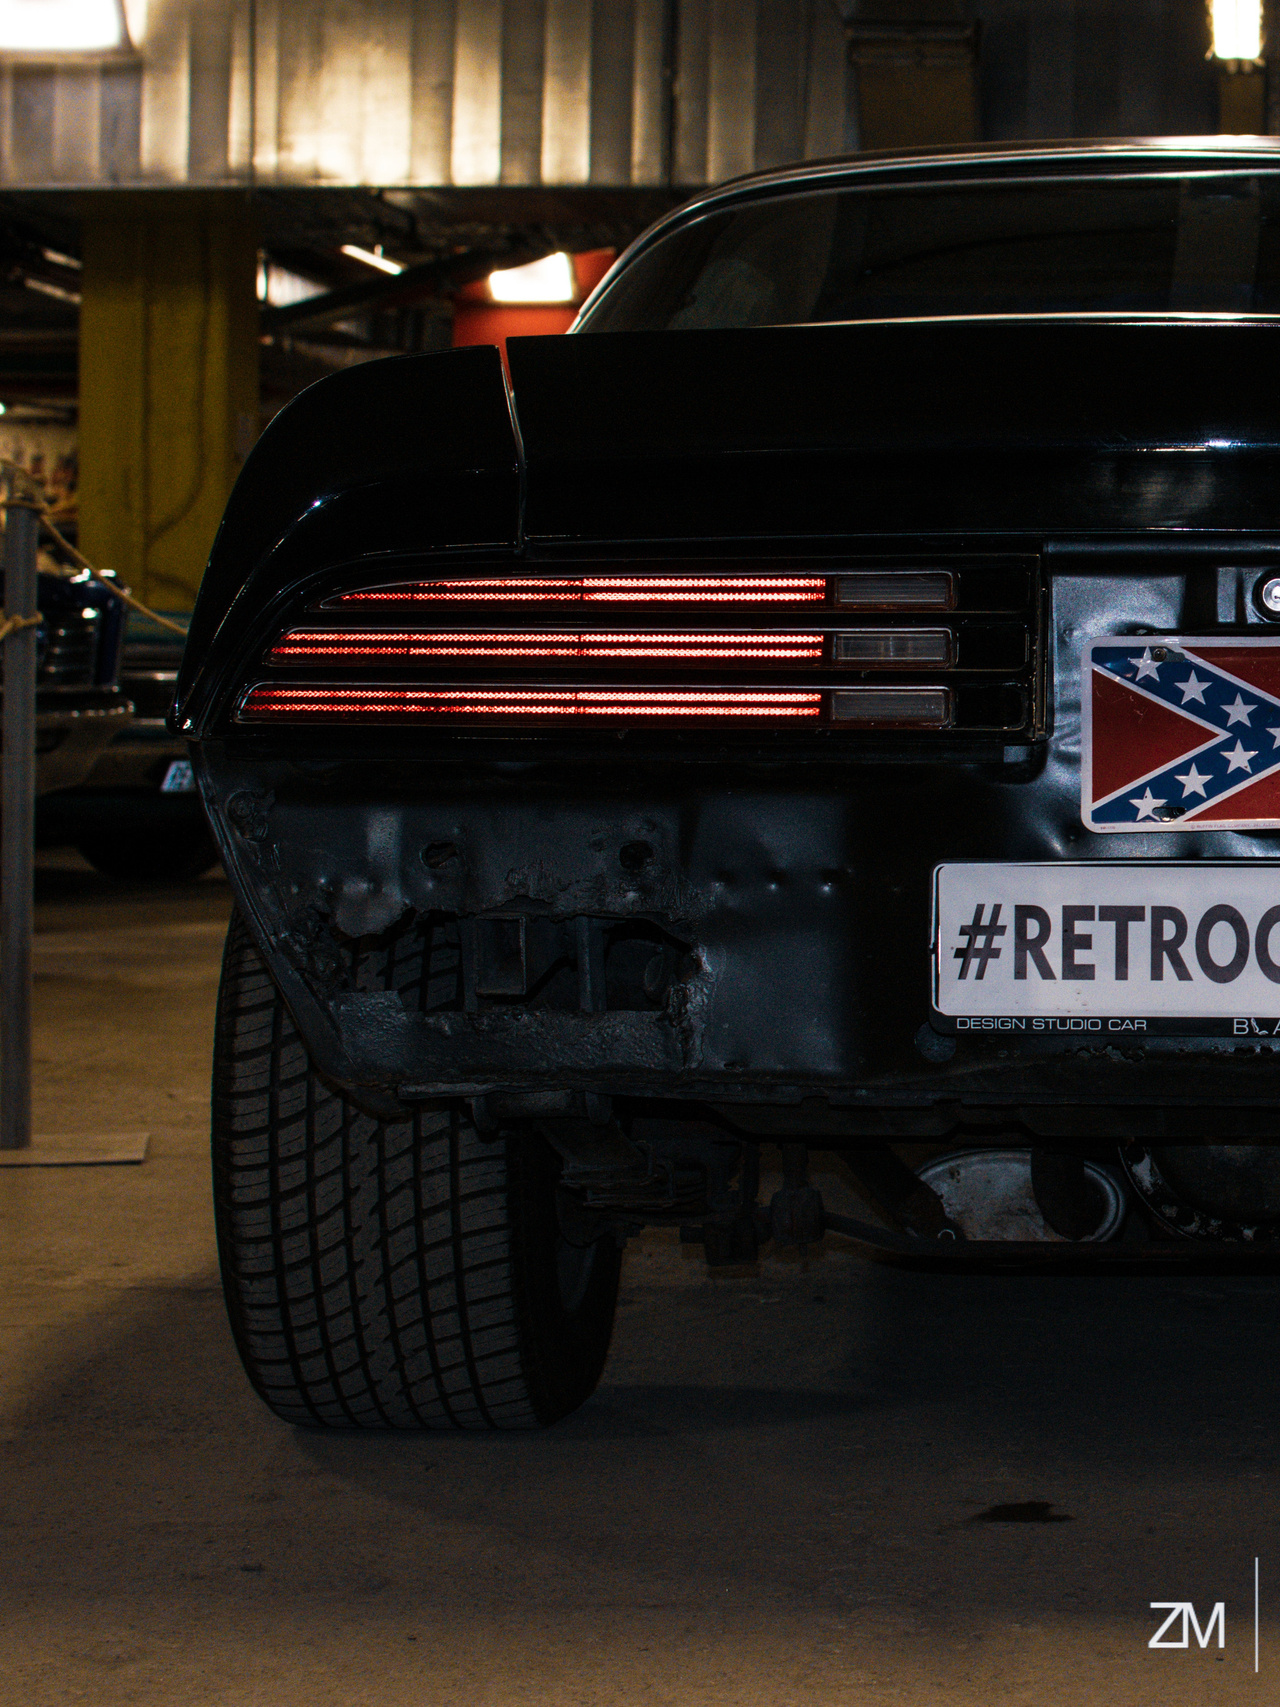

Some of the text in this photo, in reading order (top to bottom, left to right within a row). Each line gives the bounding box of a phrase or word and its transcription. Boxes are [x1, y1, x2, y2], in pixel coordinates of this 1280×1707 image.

[956, 1016, 1148, 1032] DESIGN STUDIO CAR
